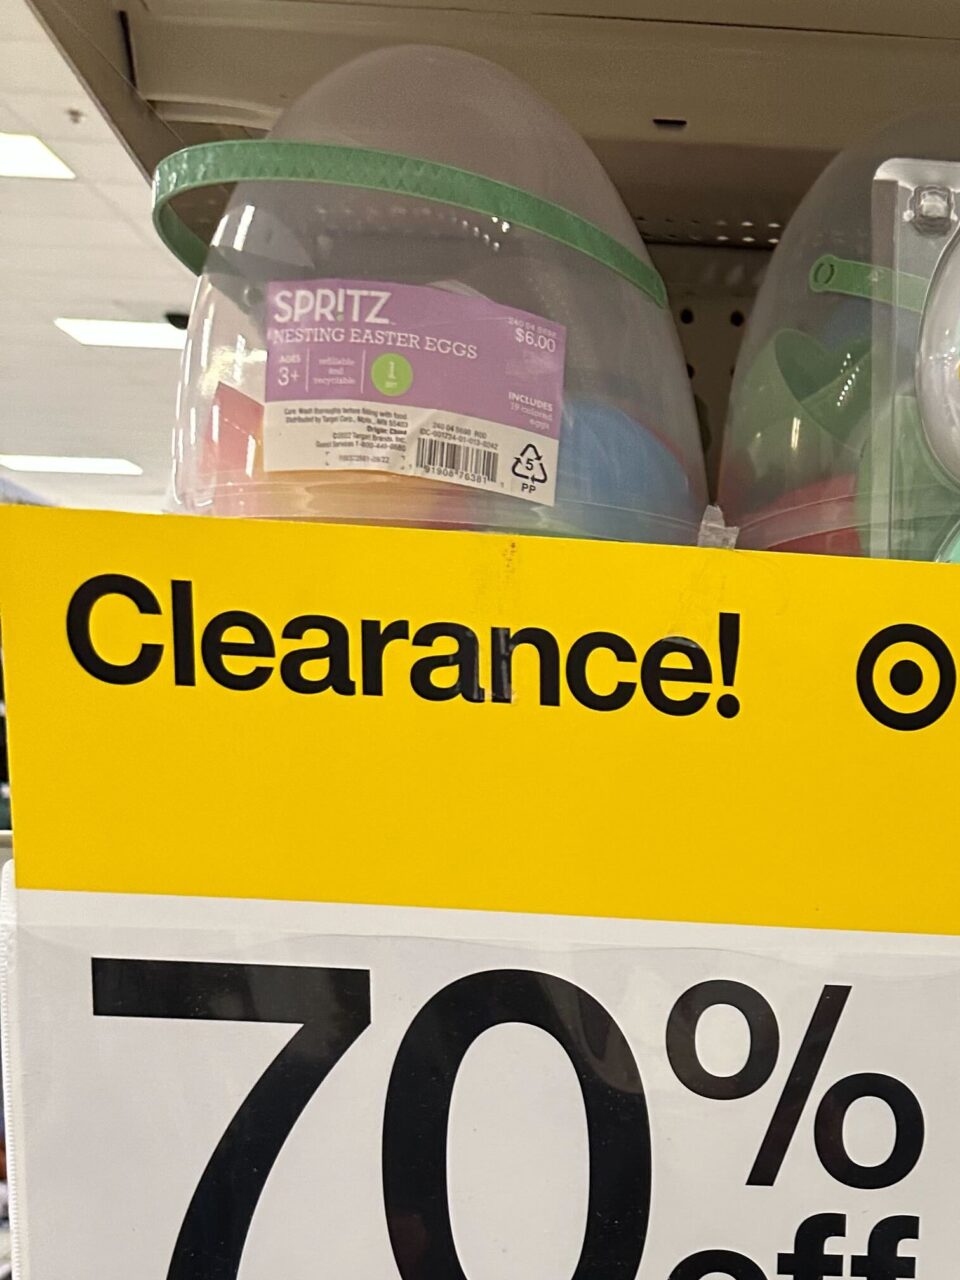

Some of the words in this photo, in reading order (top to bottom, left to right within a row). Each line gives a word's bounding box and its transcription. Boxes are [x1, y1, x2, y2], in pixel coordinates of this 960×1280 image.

[273, 327, 345, 345] NESTING
[350, 328, 421, 350] EASTER
[424, 336, 478, 360] EGGS
[515, 327, 556, 352] $6.00
[277, 366, 301, 386] 3+
[508, 391, 553, 412] INCLUDES
[525, 458, 535, 471] 5
[520, 482, 537, 495] PP
[65, 571, 742, 719] Clearance!
